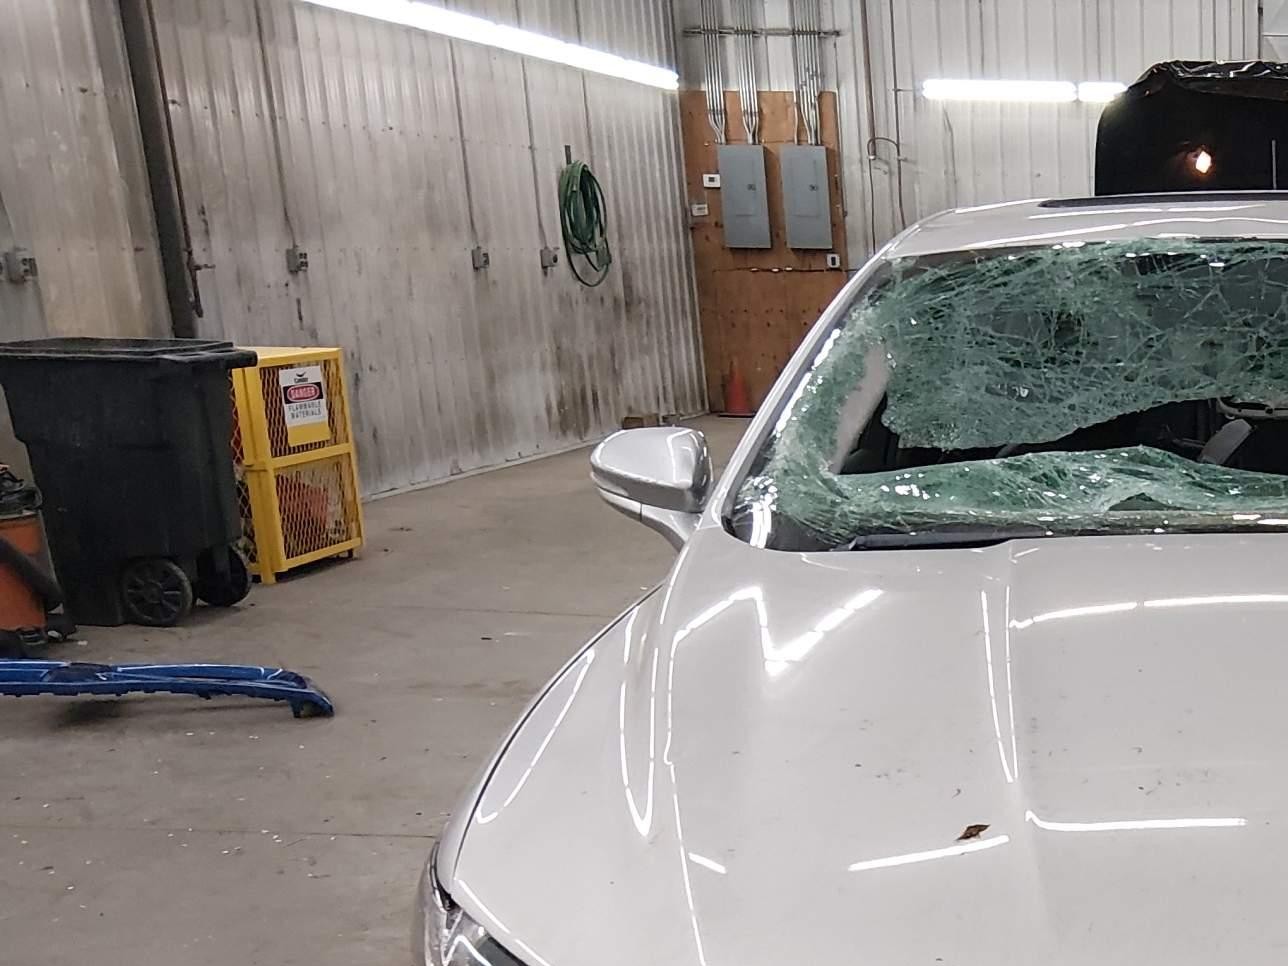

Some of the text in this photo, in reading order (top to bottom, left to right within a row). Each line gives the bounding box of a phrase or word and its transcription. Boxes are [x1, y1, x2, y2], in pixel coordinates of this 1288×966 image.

[290, 386, 316, 399] DANGER
[288, 401, 321, 412] FLAMMABLE
[291, 409, 321, 419] MATERIALS
